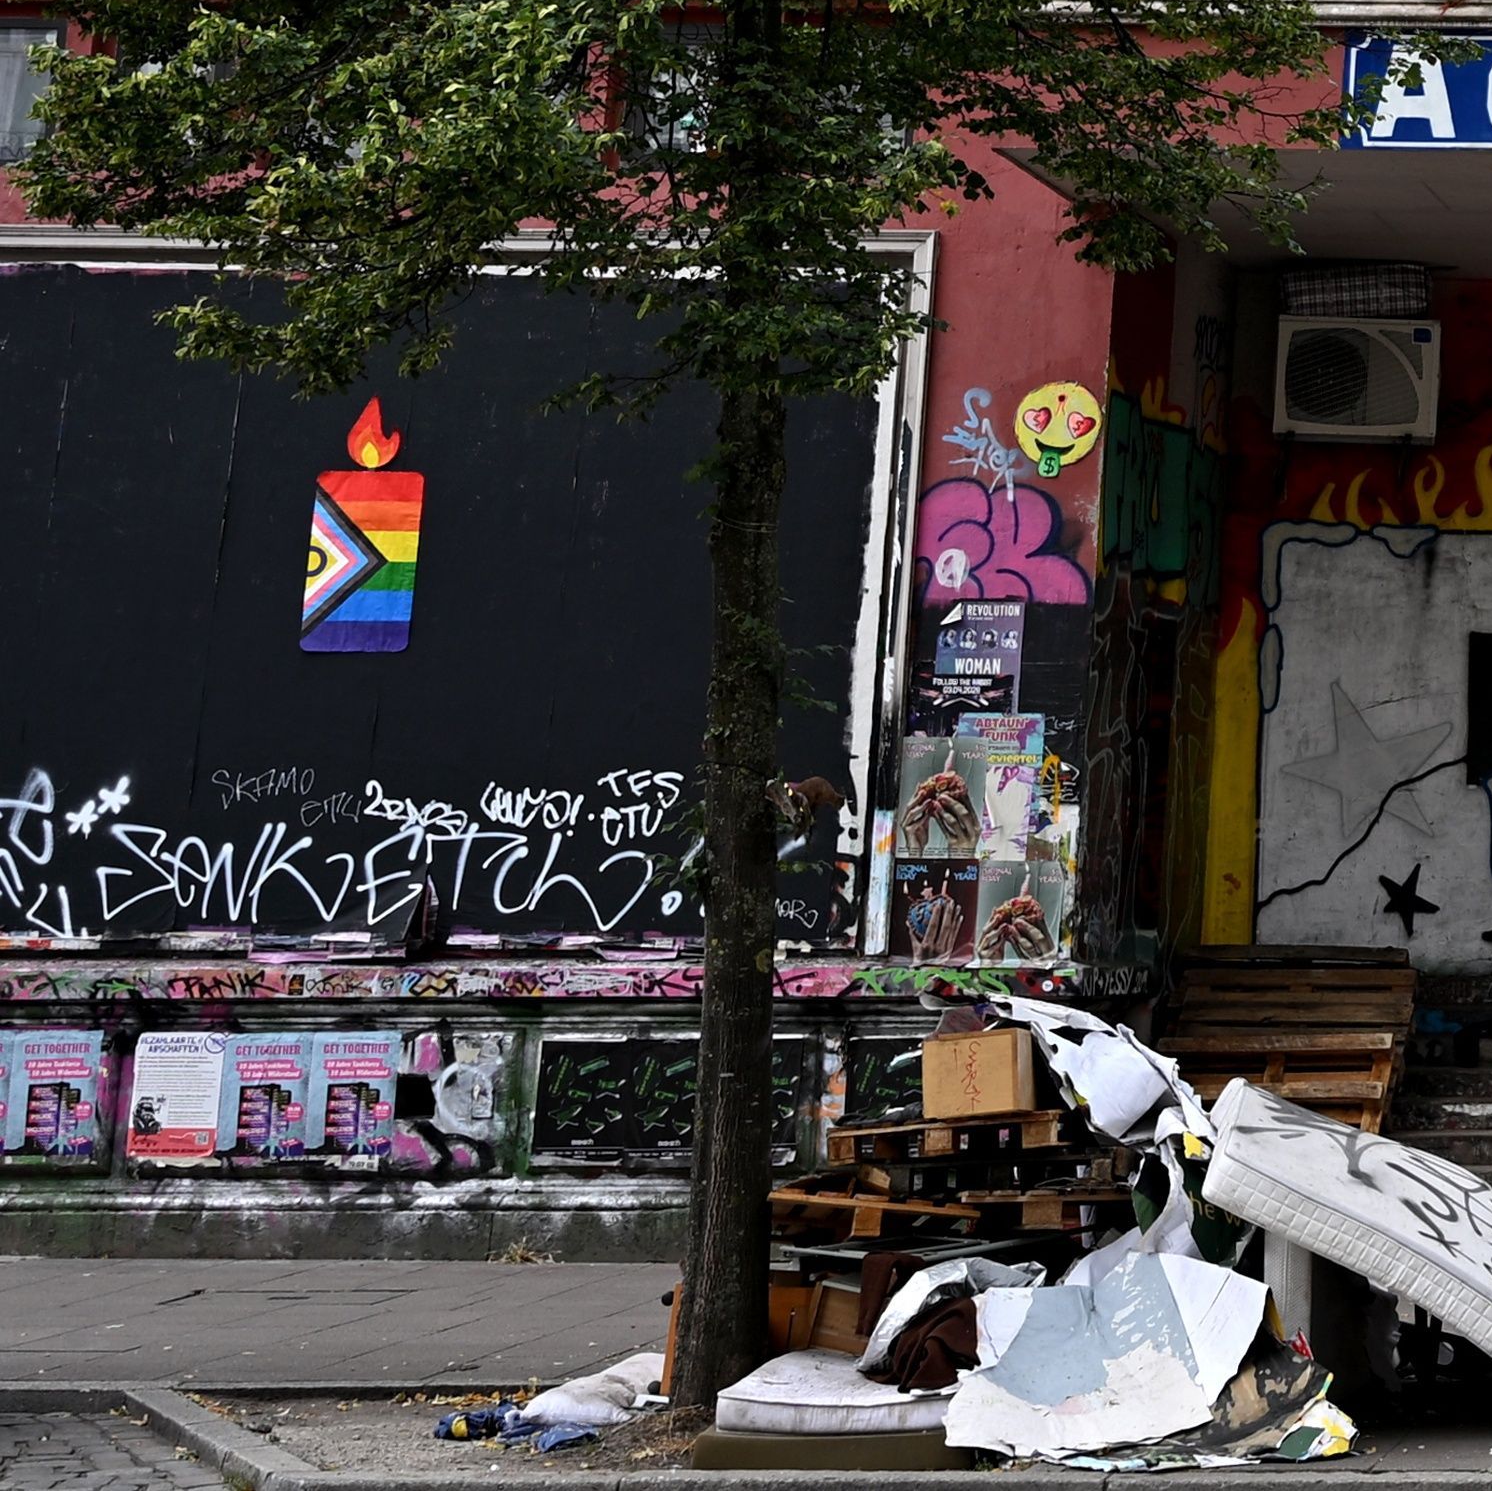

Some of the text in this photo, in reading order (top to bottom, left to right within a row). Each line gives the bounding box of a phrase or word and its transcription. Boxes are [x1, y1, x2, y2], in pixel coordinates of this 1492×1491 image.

[967, 605, 1021, 617] REVOLUTION
[955, 658, 1001, 675] WOMAN
[25, 1043, 91, 1054] GET TOGETHER
[236, 1044, 301, 1055] GET TOGETHER
[324, 1043, 390, 1054] GET TOGETHER
